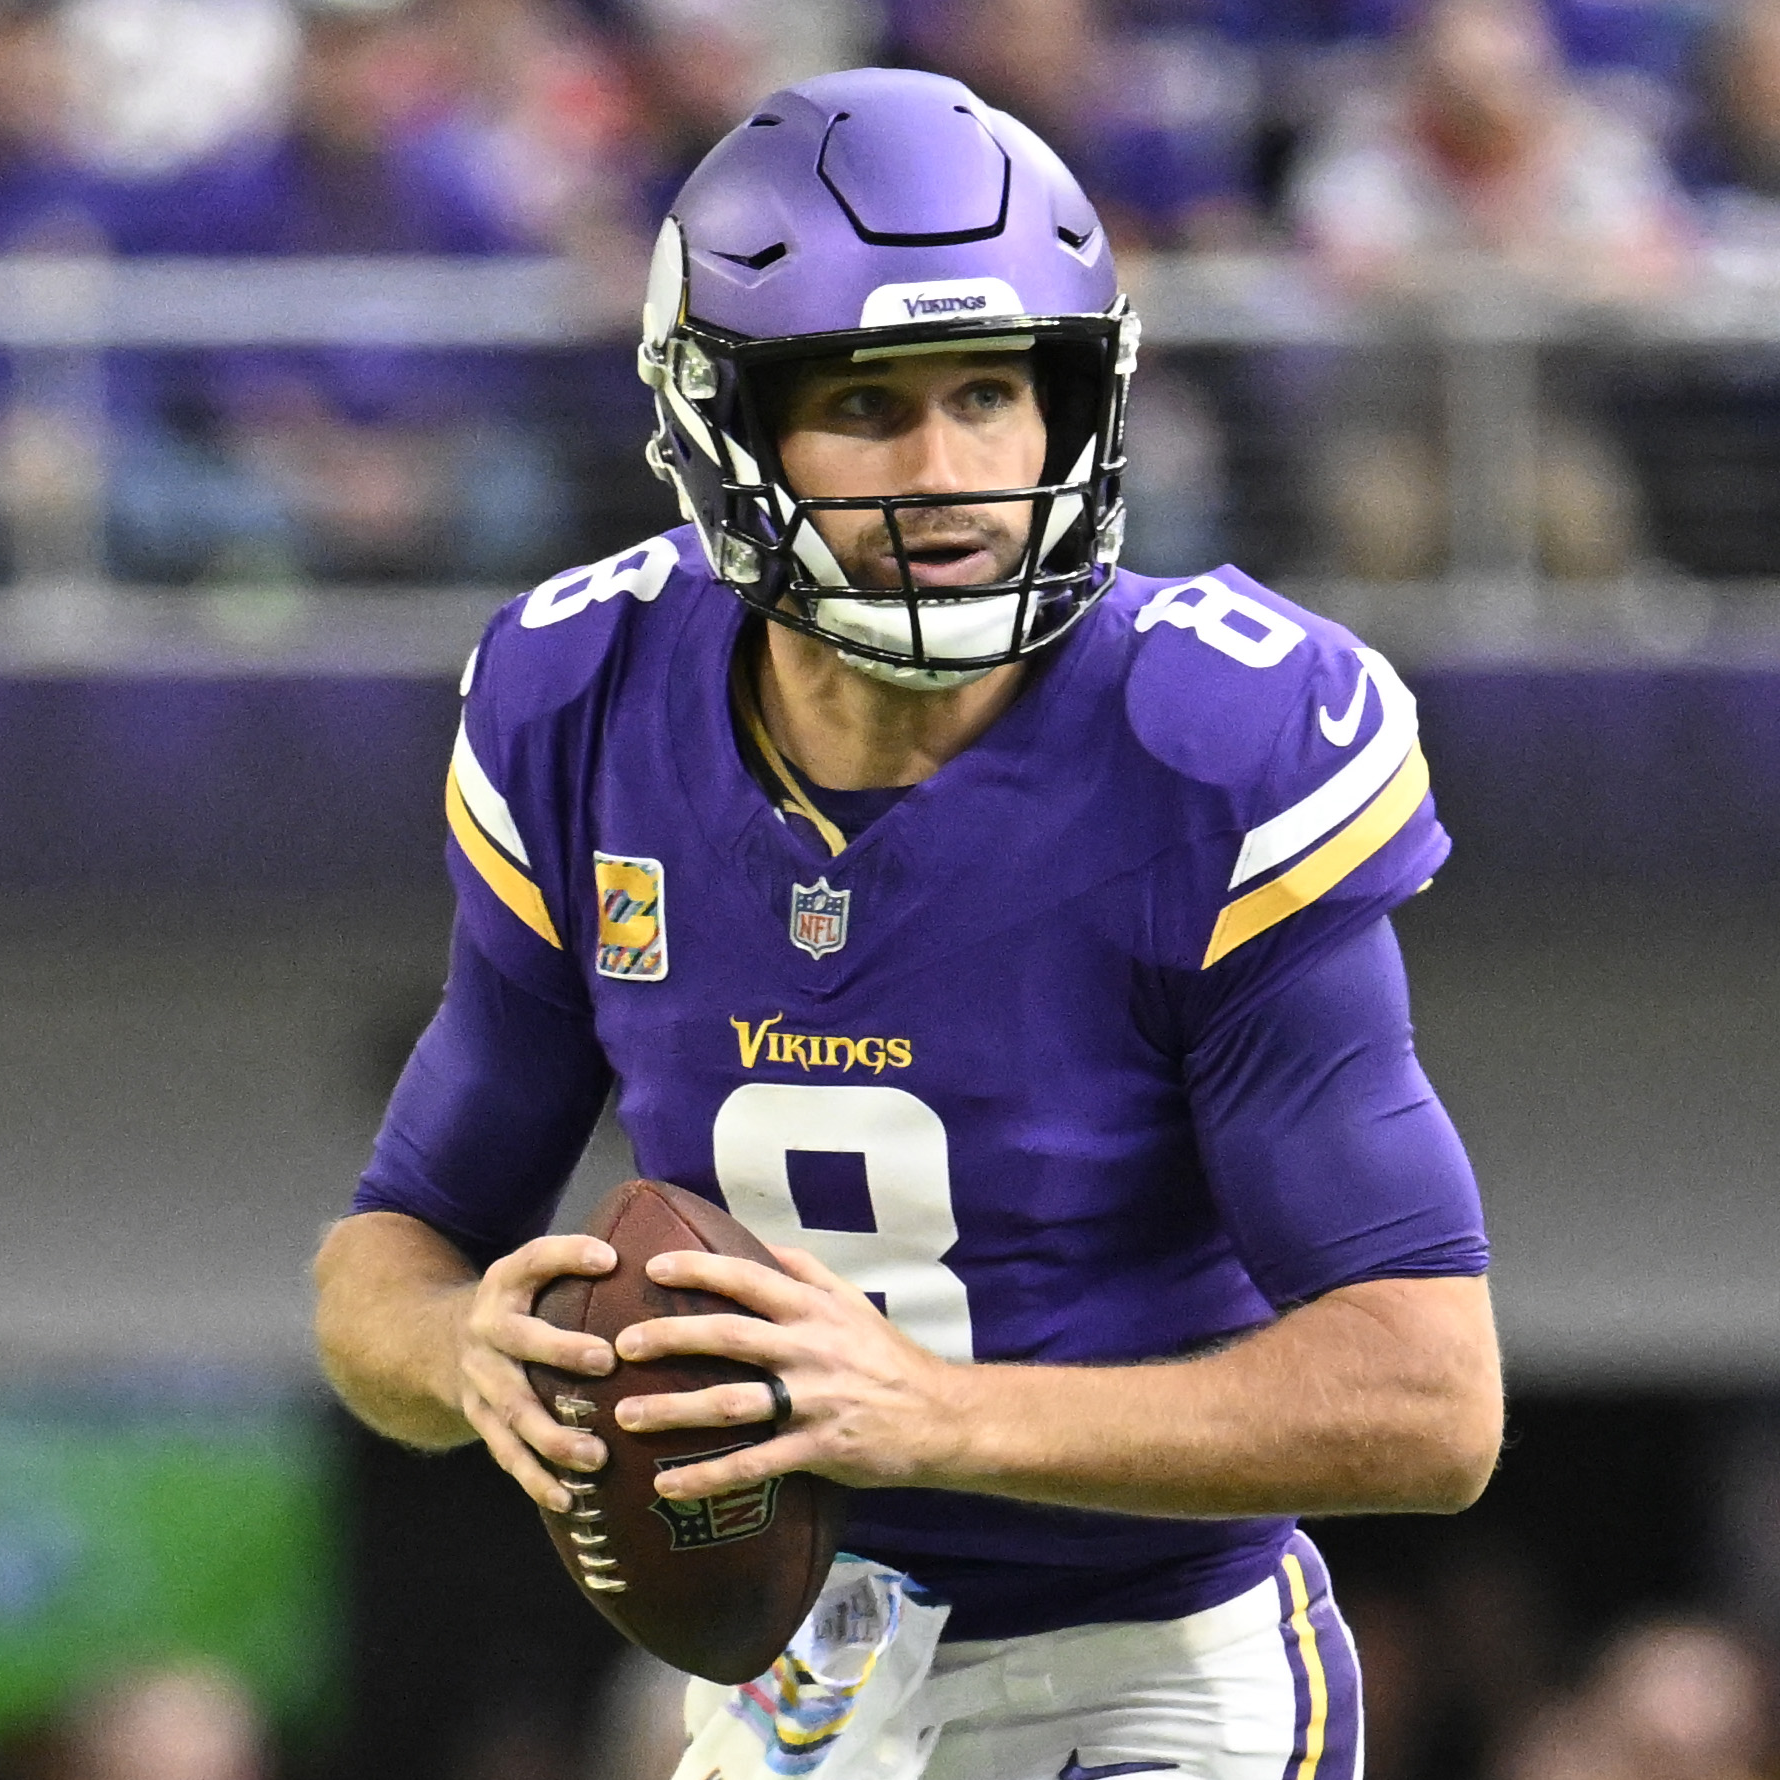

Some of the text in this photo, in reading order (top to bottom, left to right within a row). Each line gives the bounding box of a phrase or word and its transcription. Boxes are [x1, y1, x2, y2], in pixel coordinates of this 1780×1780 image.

[520, 535, 681, 629] 8
[1134, 575, 1308, 668] 8
[799, 913, 837, 945] NFL
[712, 1082, 974, 1365] 8
